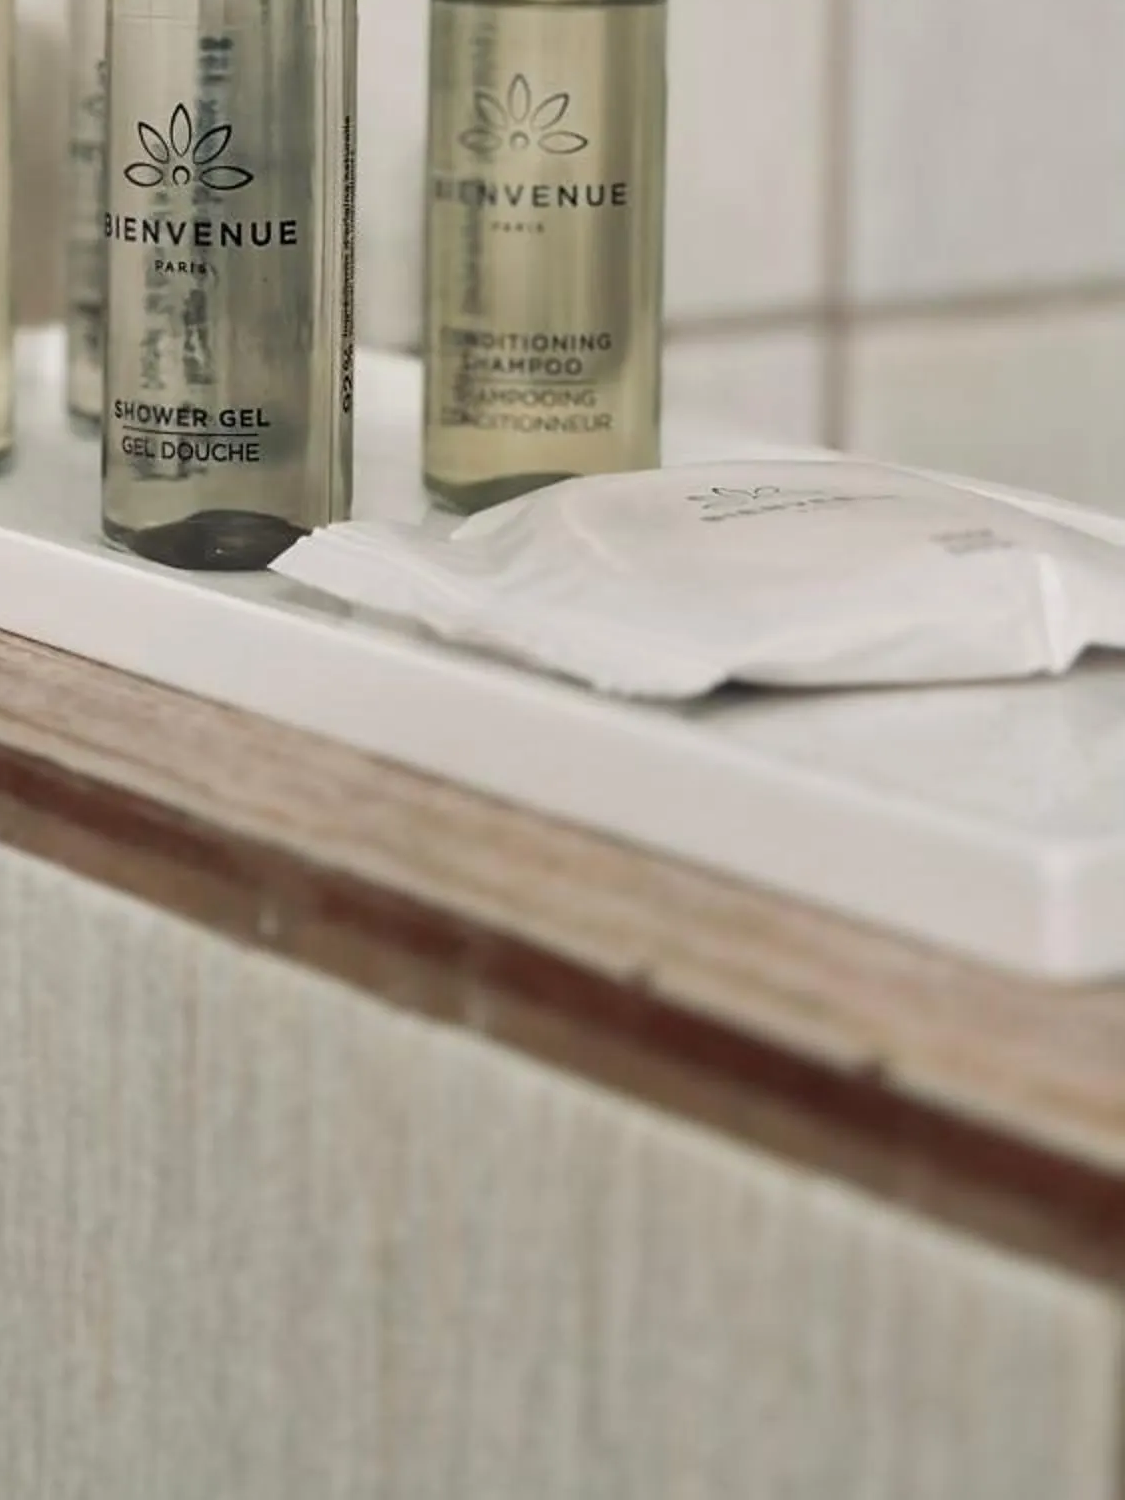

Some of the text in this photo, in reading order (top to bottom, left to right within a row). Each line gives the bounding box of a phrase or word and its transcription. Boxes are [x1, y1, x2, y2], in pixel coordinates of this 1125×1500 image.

[105, 212, 297, 247] BIENVENUE
[154, 259, 207, 274] PARIS
[114, 399, 270, 428] SHOWER GEL
[122, 435, 260, 462] GEL DOUCHE
